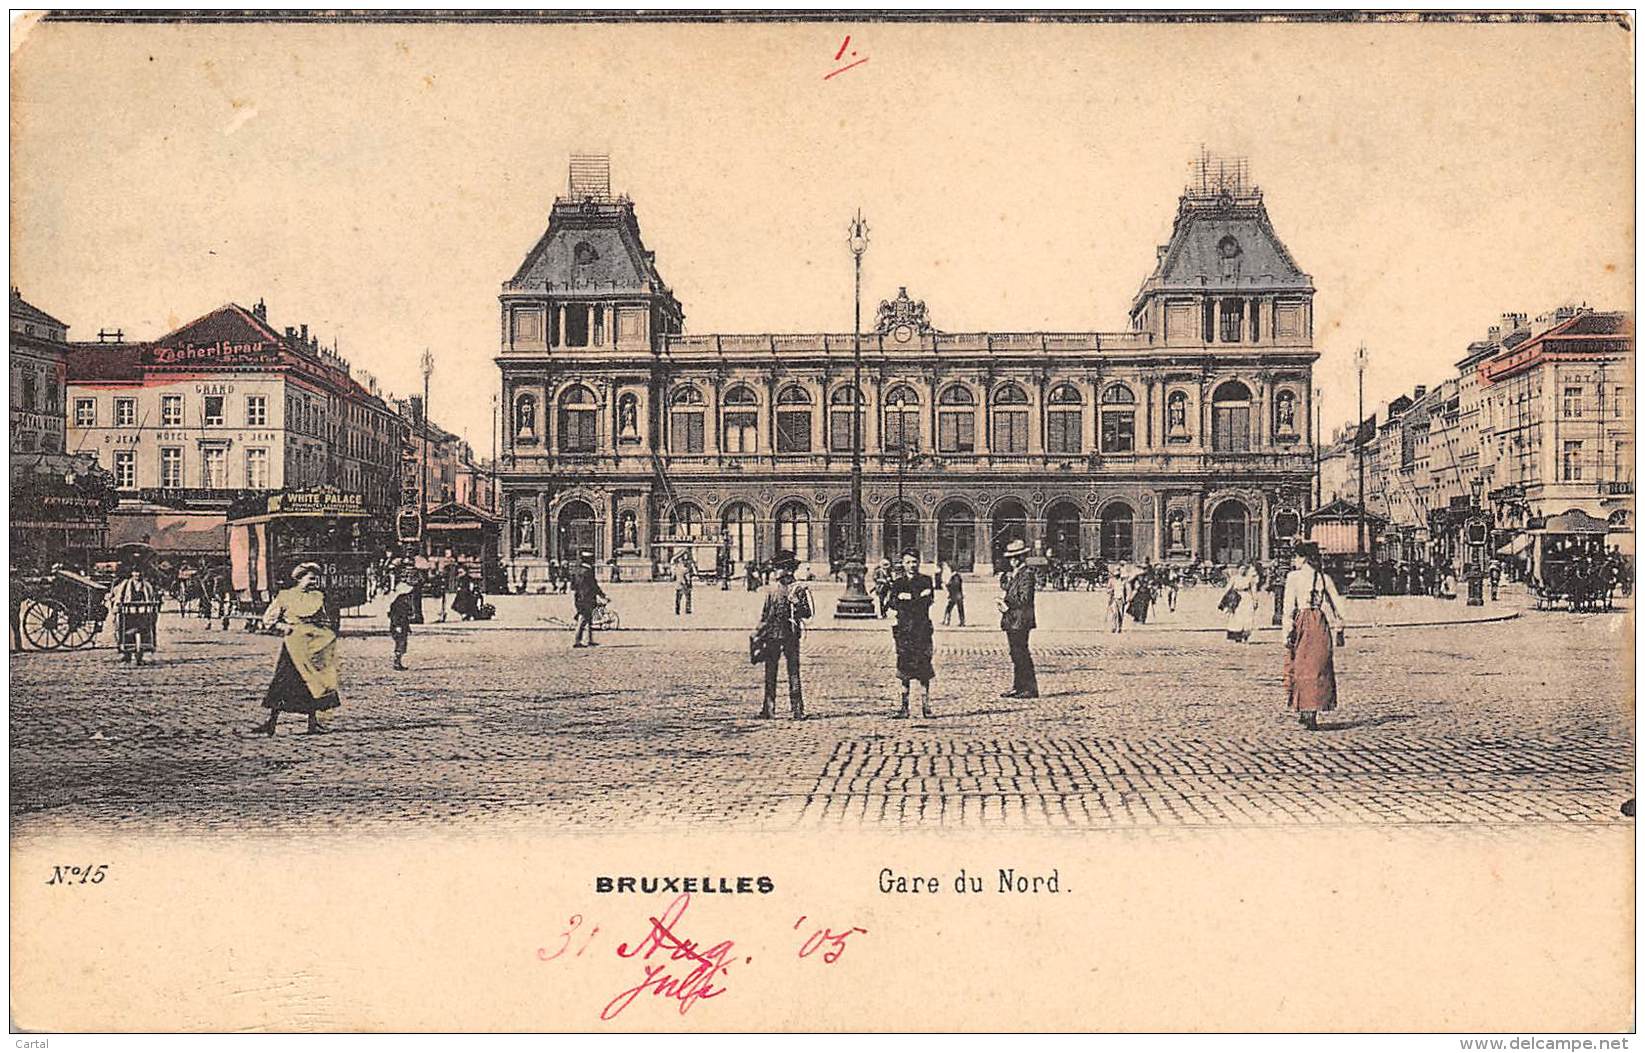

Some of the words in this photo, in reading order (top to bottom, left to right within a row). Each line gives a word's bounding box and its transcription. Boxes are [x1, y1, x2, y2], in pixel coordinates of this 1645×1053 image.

[195, 384, 234, 395] GRAND
[116, 436, 142, 444] JEAN
[251, 433, 276, 442] JEAN
[287, 493, 321, 504] WHITE
[325, 494, 362, 505] PALACE
[323, 563, 337, 575] 16
[314, 575, 327, 588] ON
[596, 876, 775, 893] BRUXELLES
[879, 868, 940, 893] Gare
[954, 868, 983, 893] du
[998, 868, 1072, 893] Nord.
